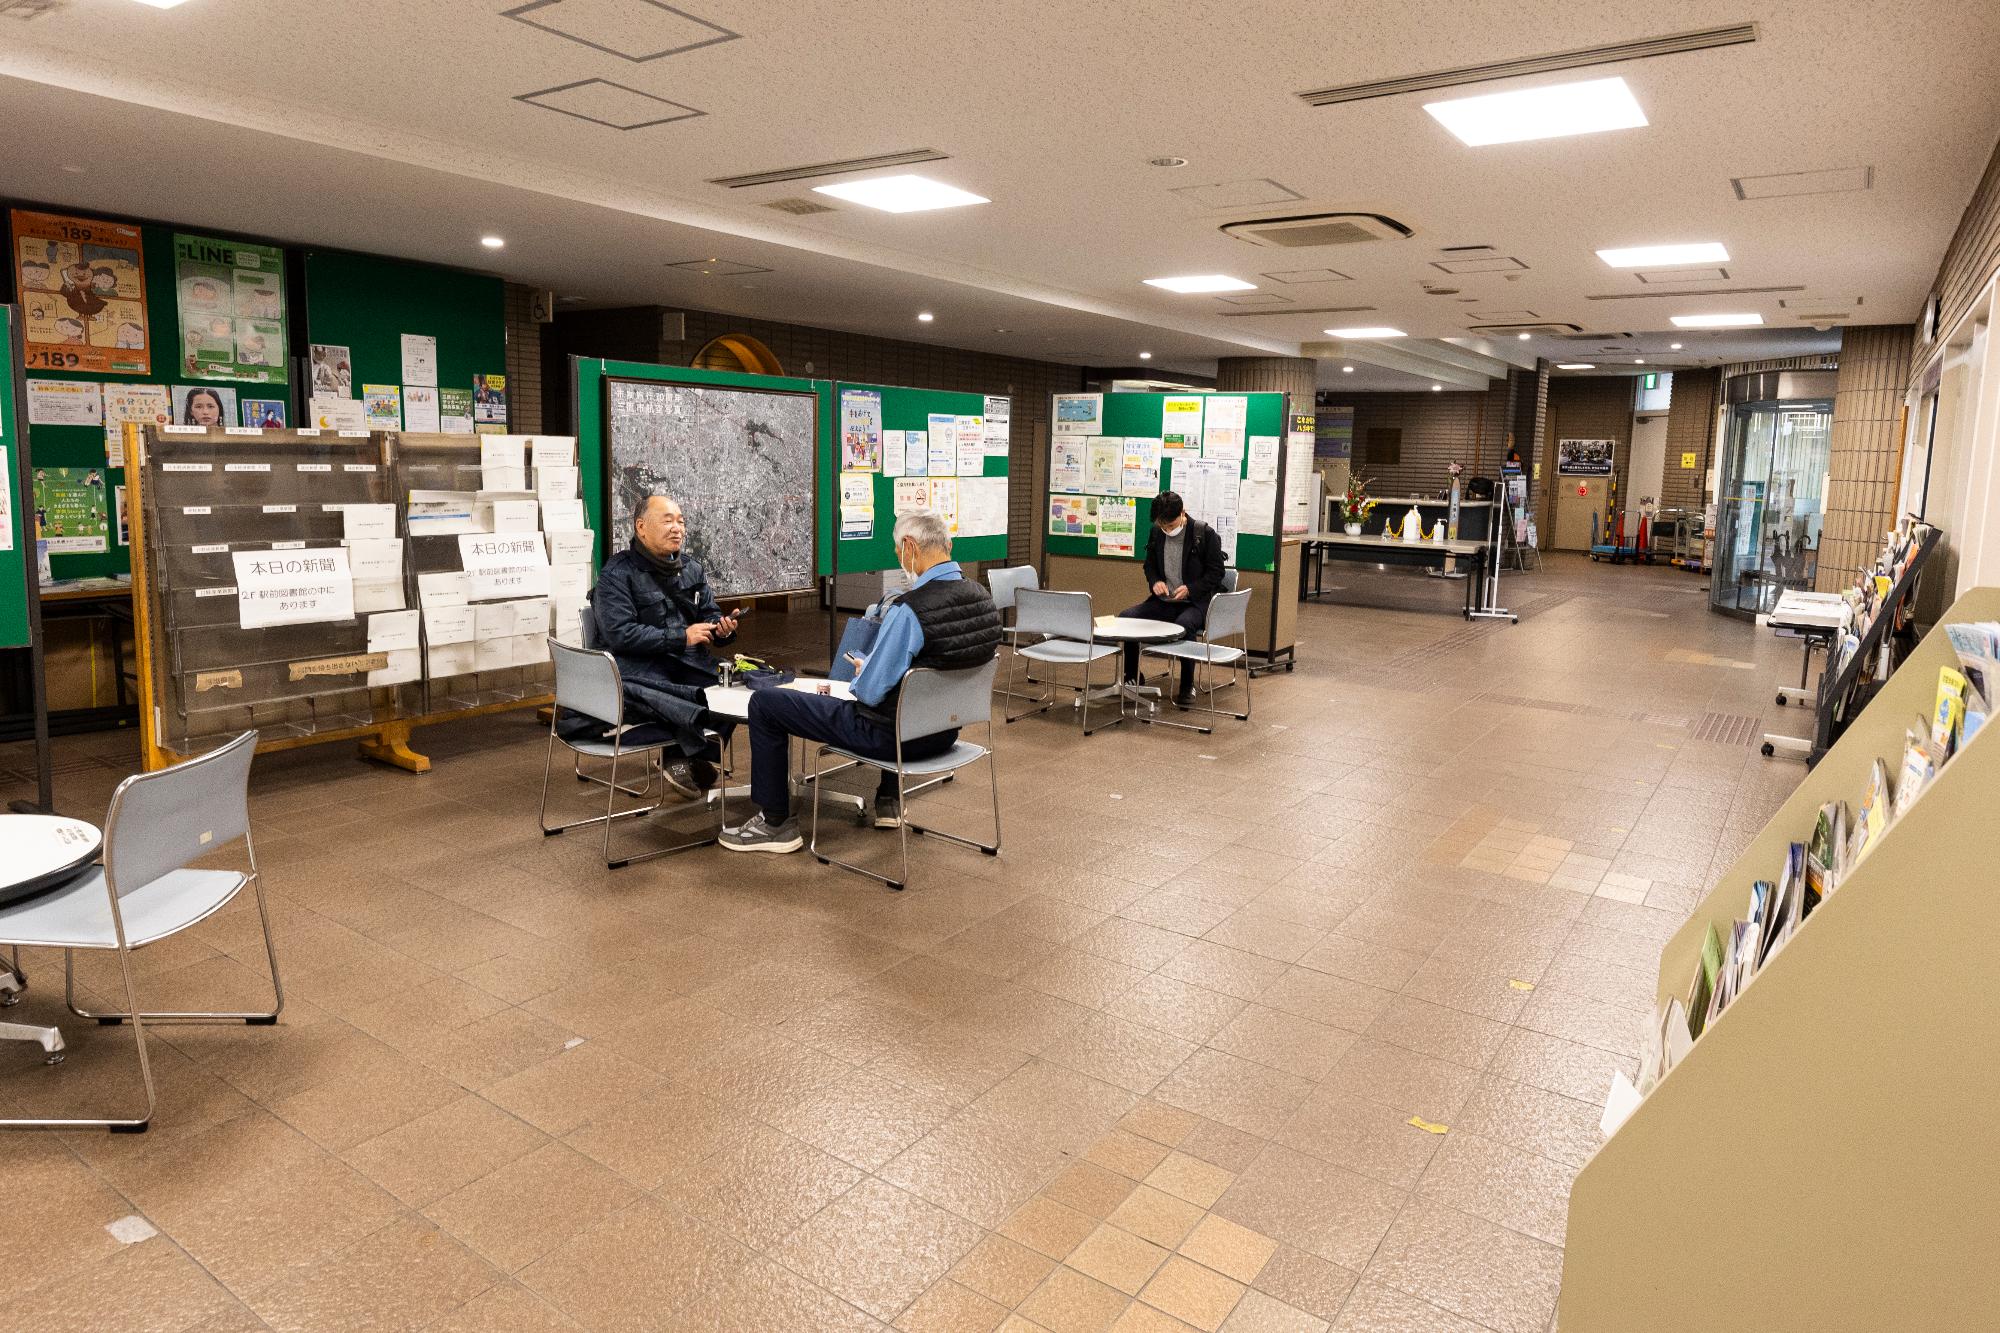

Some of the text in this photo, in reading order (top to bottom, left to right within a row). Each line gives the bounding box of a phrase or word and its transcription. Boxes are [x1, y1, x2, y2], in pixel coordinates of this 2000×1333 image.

[61, 226, 92, 241] 189
[188, 243, 233, 265] LINE
[40, 351, 79, 367] 189
[472, 540, 535, 555] 本日の新聞
[249, 558, 336, 576] 本日の新聞
[478, 565, 536, 576] 駅前図書館の中に
[495, 577, 522, 585] あります
[241, 586, 336, 600] 2F 駅前図書館の中に
[279, 600, 317, 611] あります
